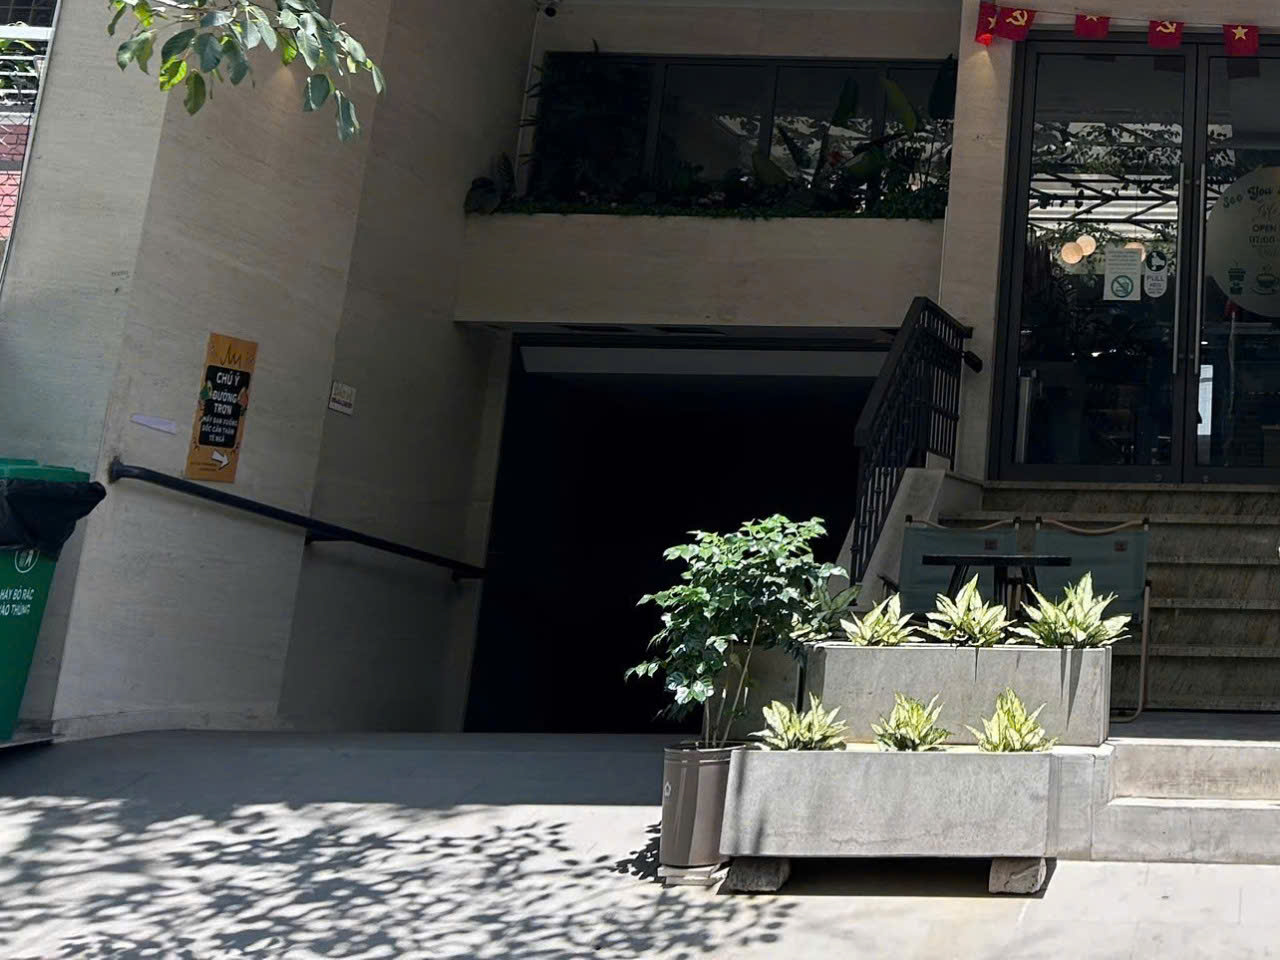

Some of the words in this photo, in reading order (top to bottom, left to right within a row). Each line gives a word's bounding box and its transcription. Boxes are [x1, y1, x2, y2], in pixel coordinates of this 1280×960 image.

[1252, 224, 1277, 233] OPEN
[216, 371, 233, 385] CHÚ
[234, 372, 241, 386] Ý
